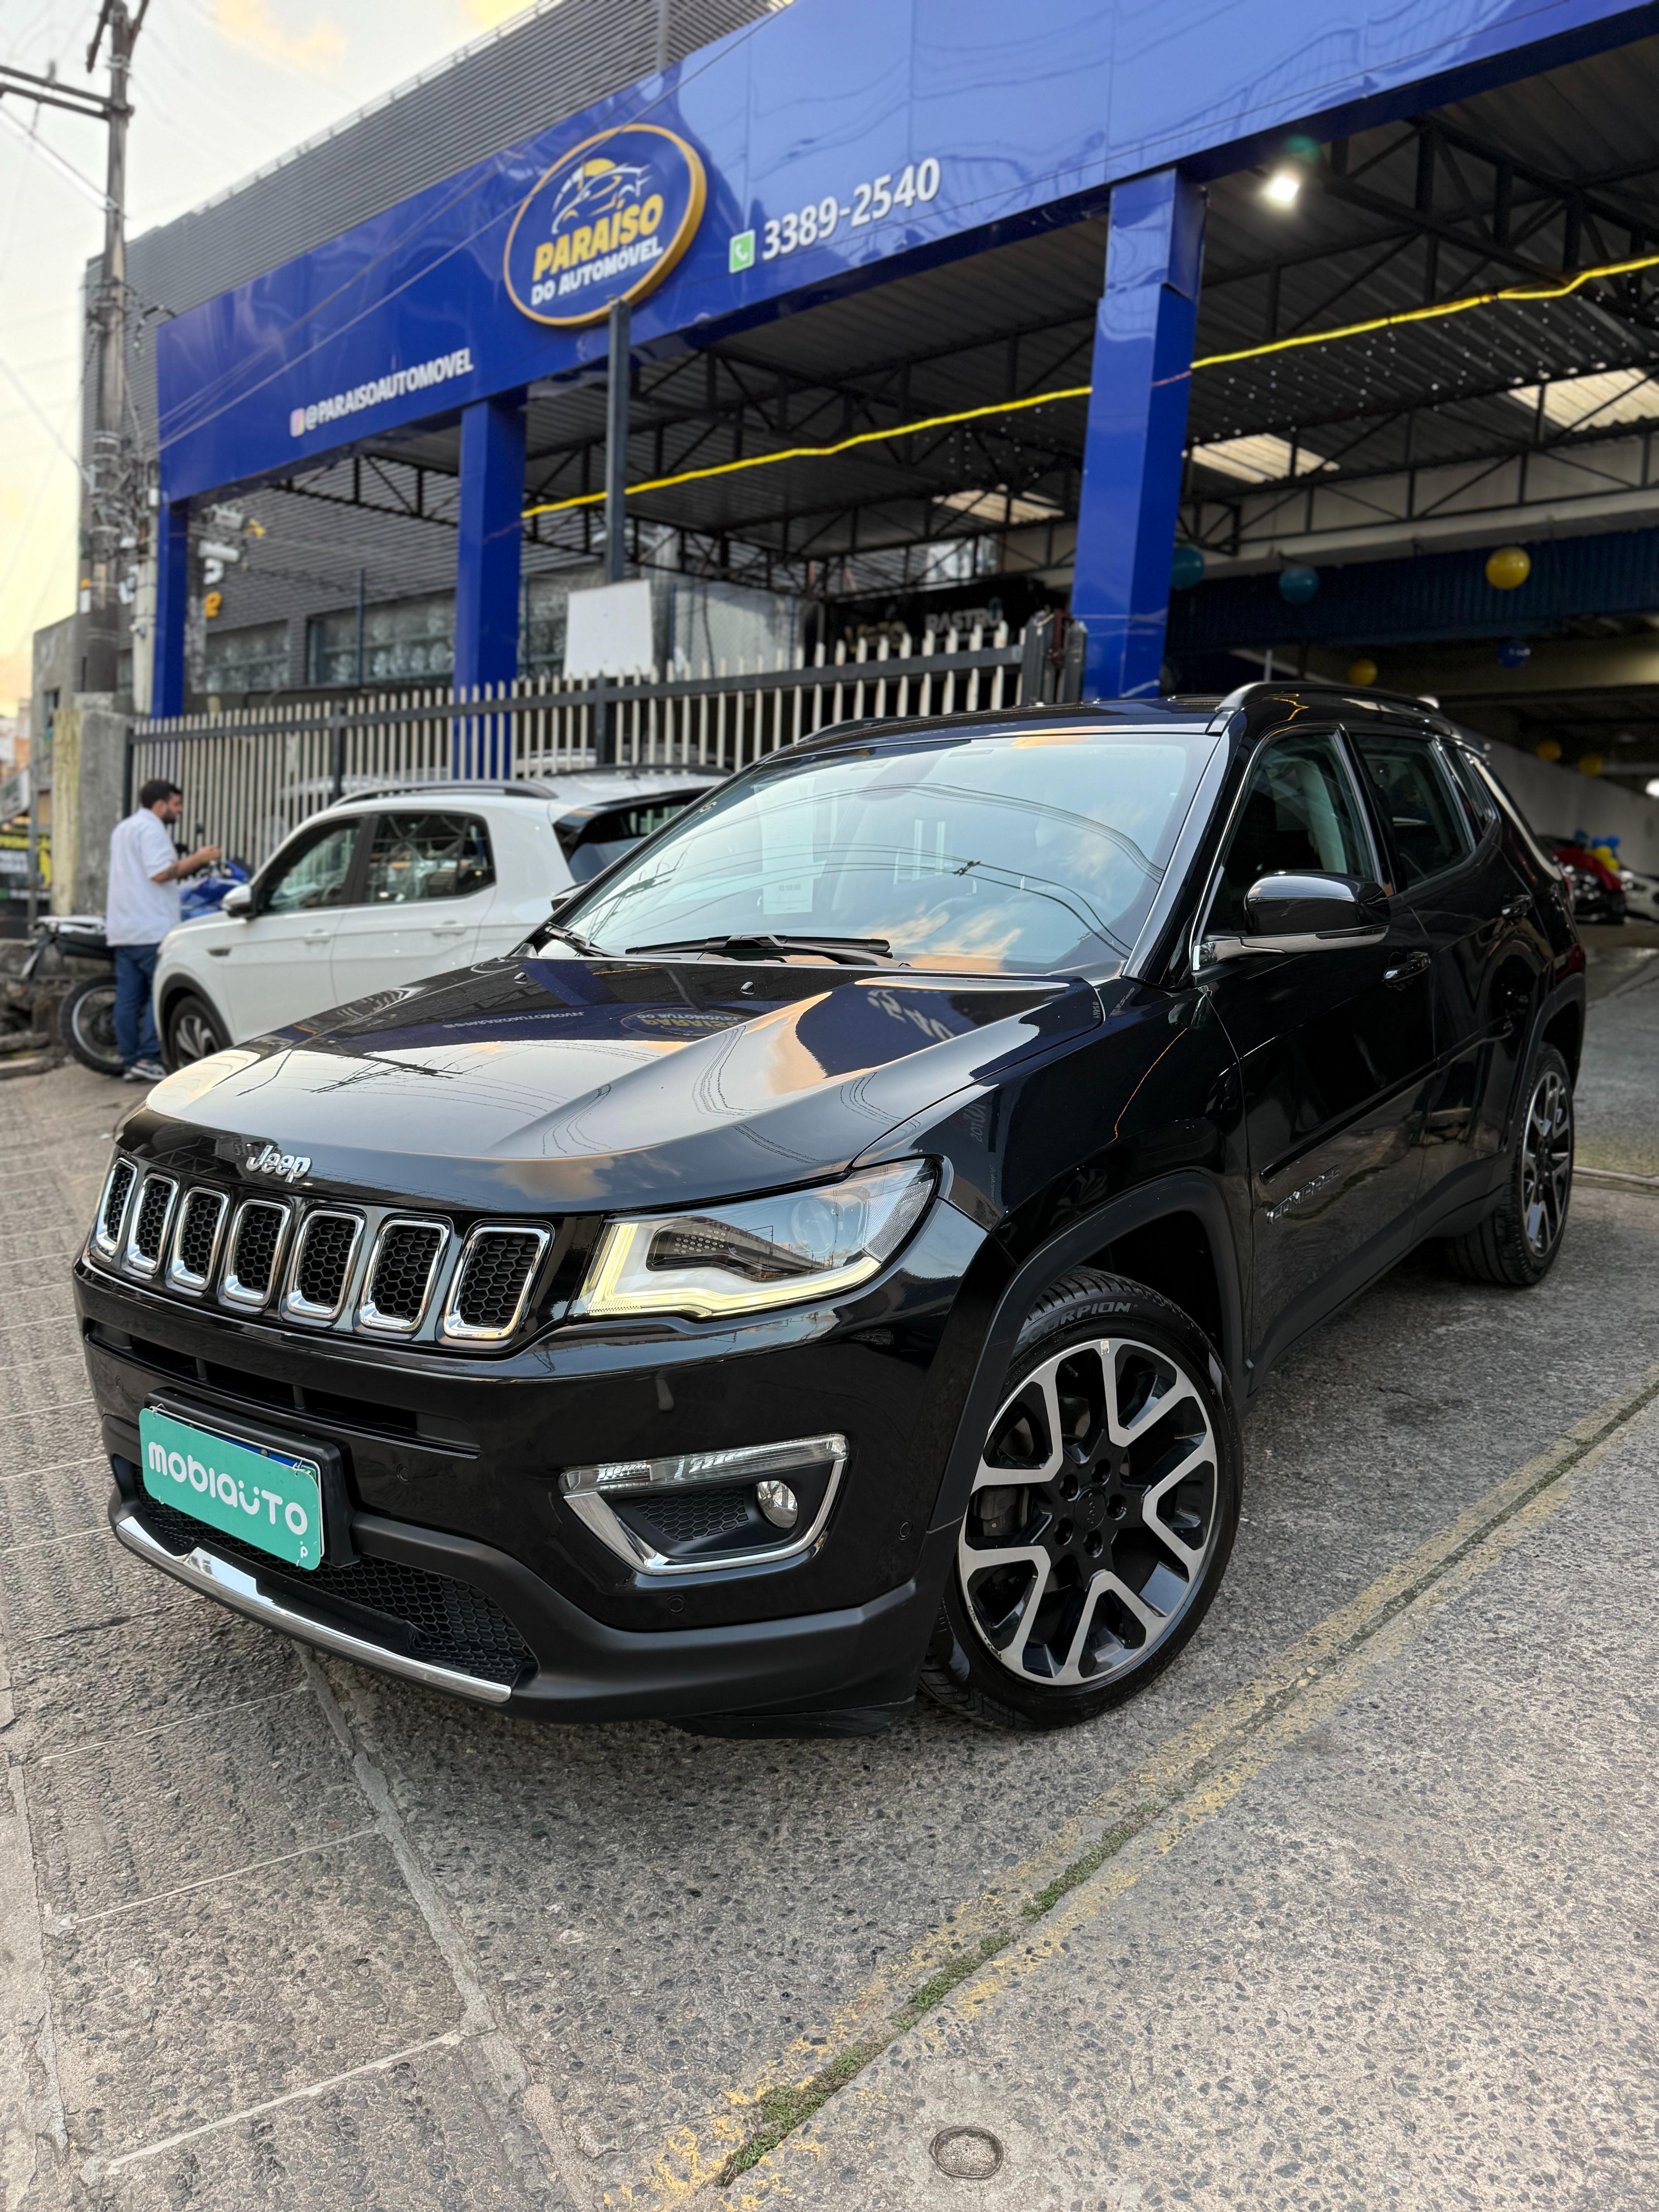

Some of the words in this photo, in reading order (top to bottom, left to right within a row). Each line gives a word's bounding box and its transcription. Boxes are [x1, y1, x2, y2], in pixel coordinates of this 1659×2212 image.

[532, 193, 663, 282] PARAÍSO
[762, 157, 941, 260] 3389-2540
[531, 279, 555, 306] DO
[558, 235, 663, 295] AUTOMÓVEL
[305, 347, 474, 430] @PARAISOAUTOMOVEL
[246, 1145, 311, 1183] Jeep
